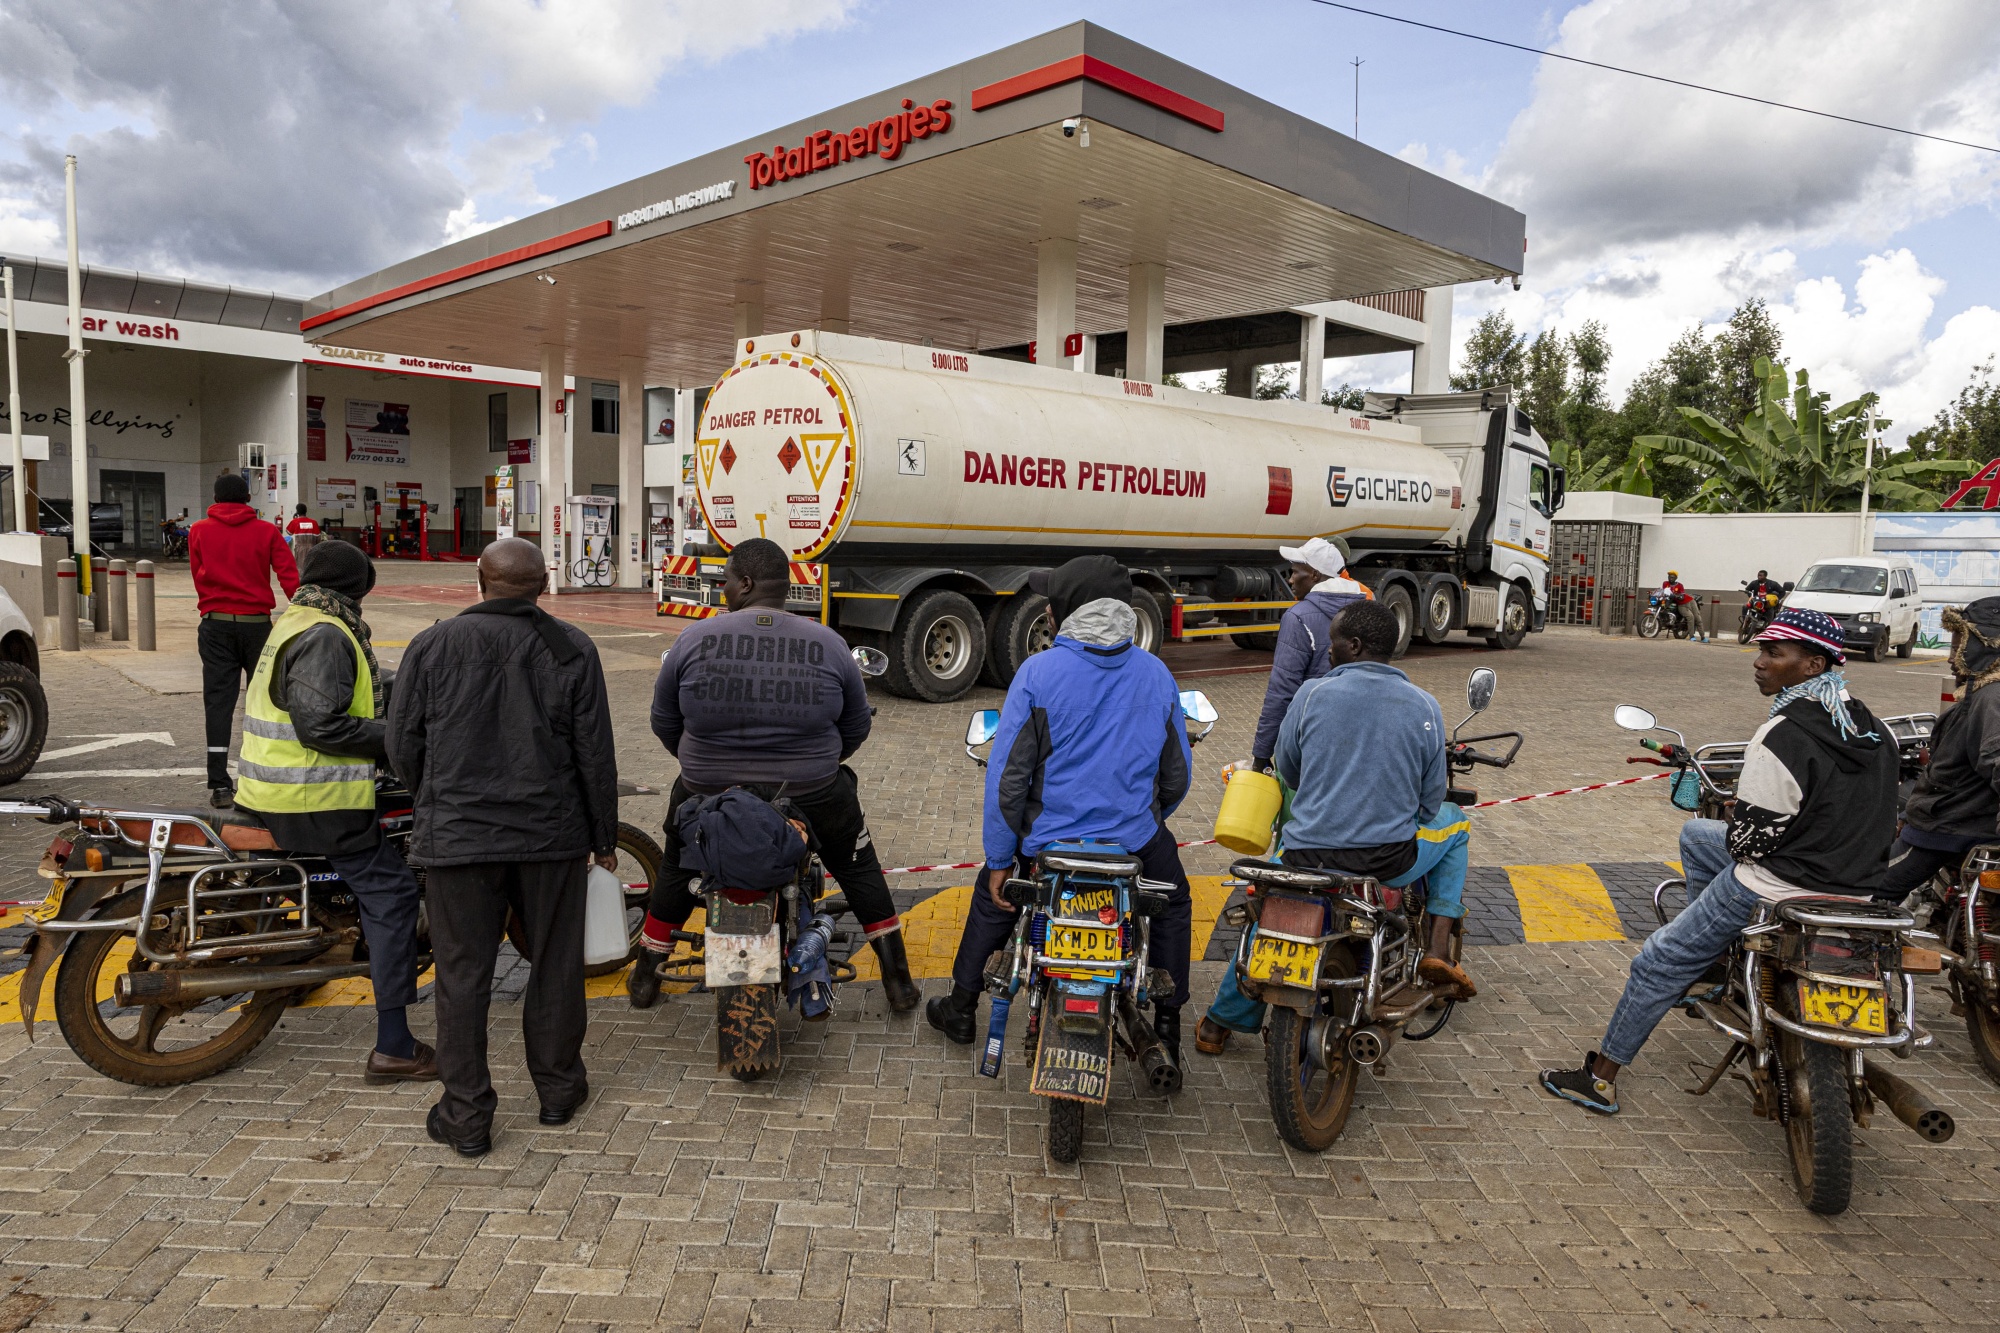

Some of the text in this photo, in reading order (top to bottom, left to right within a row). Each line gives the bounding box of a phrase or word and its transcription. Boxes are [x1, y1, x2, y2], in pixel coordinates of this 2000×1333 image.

[744, 98, 952, 190] TotalEnergies
[618, 180, 736, 231] KARATINA HIGHWAY
[67, 316, 179, 341] ar wash
[1071, 338, 1077, 352] 1
[320, 347, 473, 373] QUARTZ auto services
[953, 354, 969, 372] LTRS
[1141, 383, 1154, 398] LTRS
[557, 402, 562, 411] 5
[710, 408, 823, 431] DANGER PETROL
[53, 407, 175, 438] Rllying
[964, 450, 1206, 498] DANGER PETROLEUM
[1355, 477, 1432, 503] GICHERO
[700, 634, 825, 666] PADRINO
[751, 666, 766, 675] DE
[770, 667, 783, 677] LA
[787, 668, 822, 679] MAFIA
[693, 677, 825, 706] CORLEONE
[1059, 889, 1114, 917] KANUSH
[1044, 1047, 1107, 1074] TRIBLE
